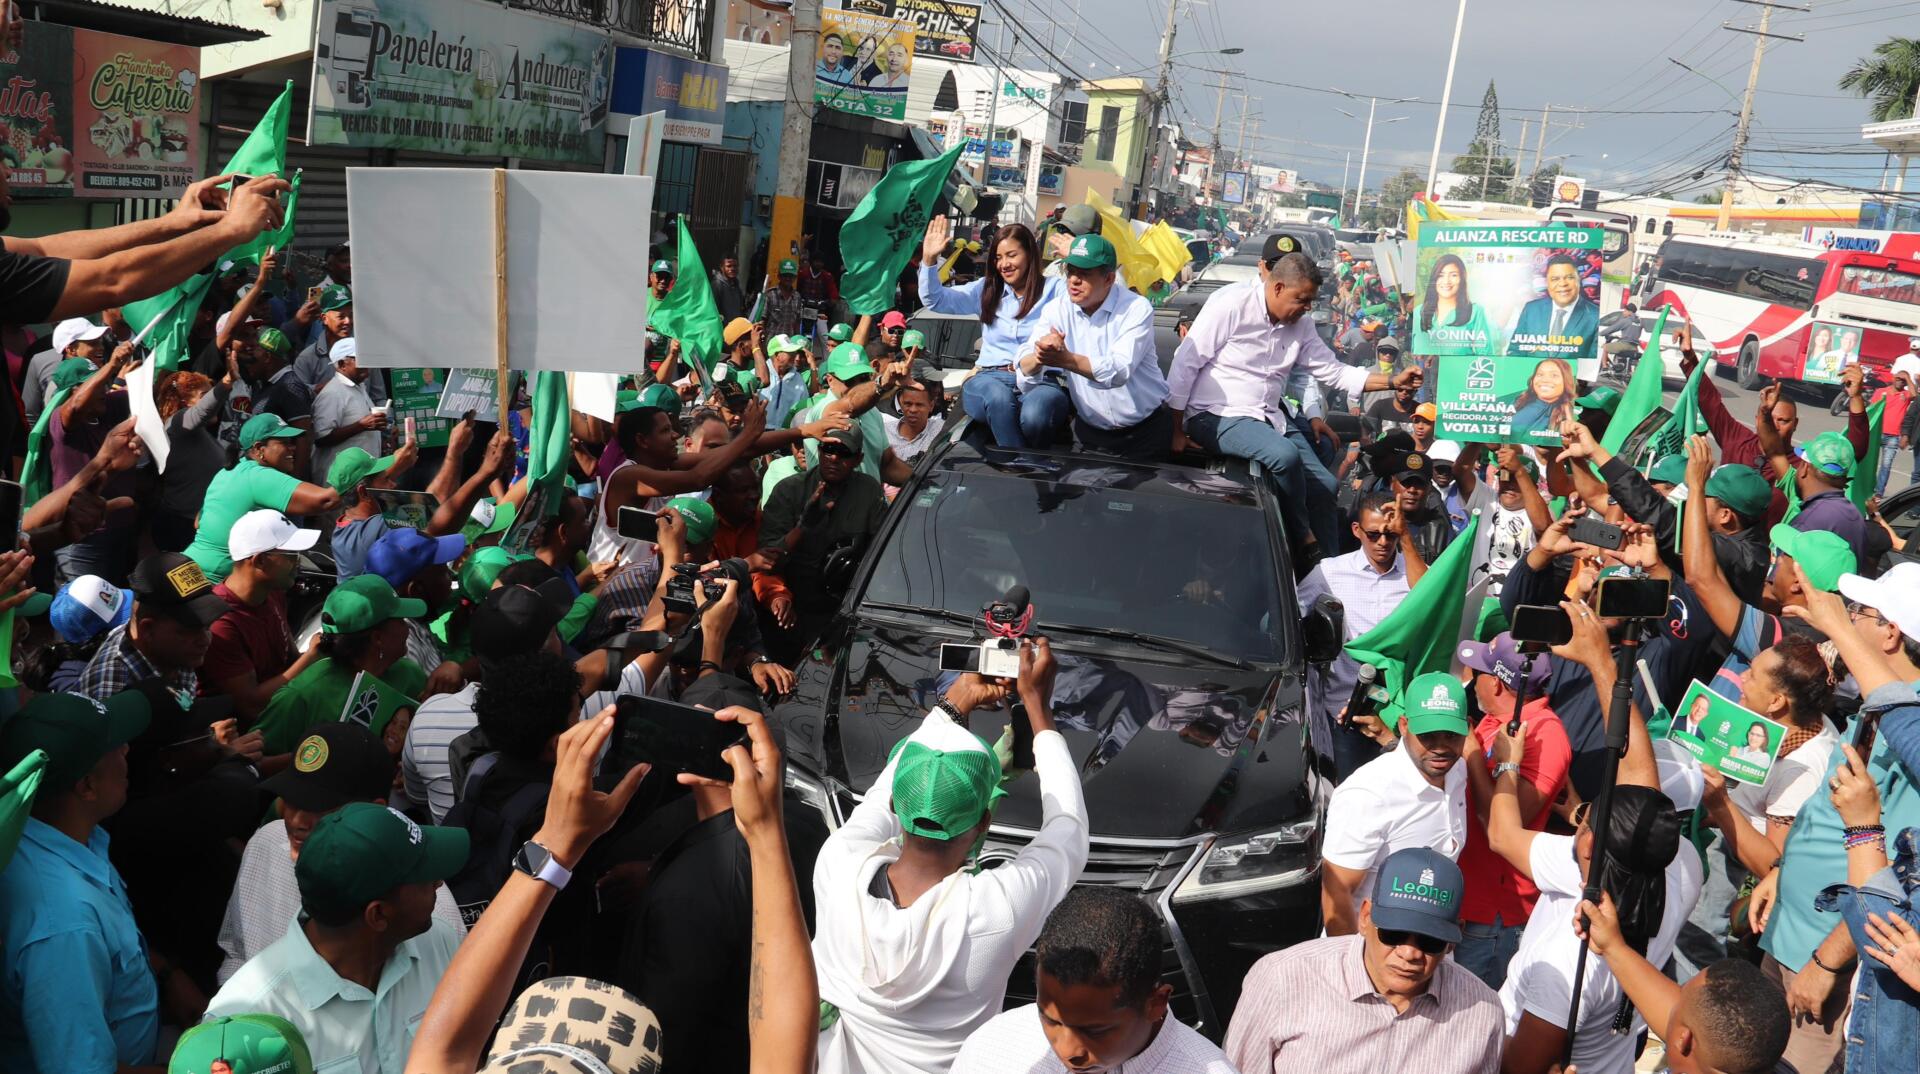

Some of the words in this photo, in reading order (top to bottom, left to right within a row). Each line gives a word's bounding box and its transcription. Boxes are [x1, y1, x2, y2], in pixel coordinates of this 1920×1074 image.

[361, 21, 473, 81] Papelería
[680, 72, 718, 112] REAL
[1003, 82, 1046, 99] KING
[821, 97, 867, 112] VOTA
[873, 105, 893, 115] 32
[341, 113, 379, 133] VENTAS
[380, 117, 391, 134] AL
[393, 118, 411, 136] POR
[413, 120, 443, 139] MAYOR
[444, 122, 450, 139] Y
[463, 125, 494, 143] DETALLE
[1435, 230, 1499, 242] ALIANZA
[1501, 230, 1564, 243] RESCATE
[1568, 231, 1589, 244] RD
[1835, 236, 1880, 253] RAYMUNDO
[1427, 329, 1487, 341] YONINA
[1519, 344, 1559, 353] SENADOR
[1560, 345, 1579, 353] 2024
[1468, 380, 1491, 388] FP
[1459, 392, 1496, 402] RUTH
[1441, 401, 1516, 414] VILLAFAÑA
[1442, 413, 1487, 422] REGIDORA
[1489, 414, 1513, 423] 24-28
[1442, 422, 1480, 434] VOTA
[1482, 423, 1496, 434] 13
[1529, 428, 1560, 438] casilla
[1421, 699, 1460, 709] LEONEL
[1391, 876, 1455, 902] Leonel
[1389, 892, 1438, 905] PRESIDENTE
